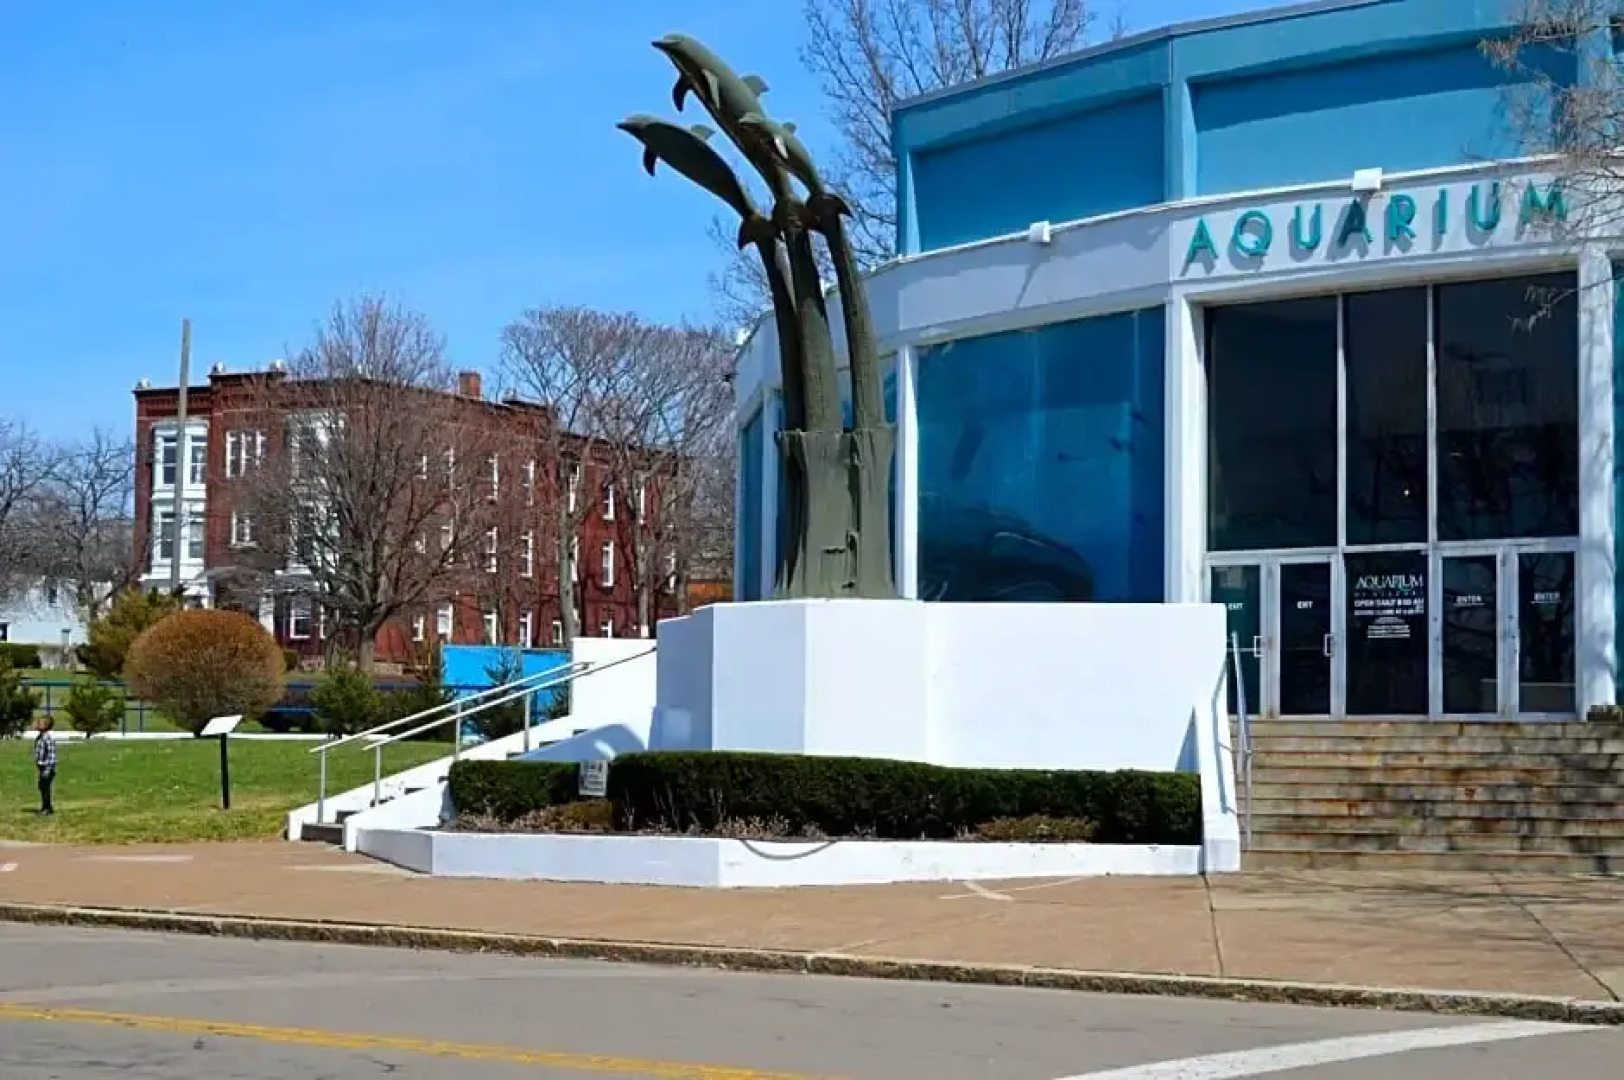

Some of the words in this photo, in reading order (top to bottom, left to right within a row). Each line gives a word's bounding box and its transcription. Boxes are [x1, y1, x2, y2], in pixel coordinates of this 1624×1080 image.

[1186, 178, 1568, 263] AQUARIUM
[1355, 574, 1423, 590] AQUARIUM
[1297, 600, 1313, 609] EXIT
